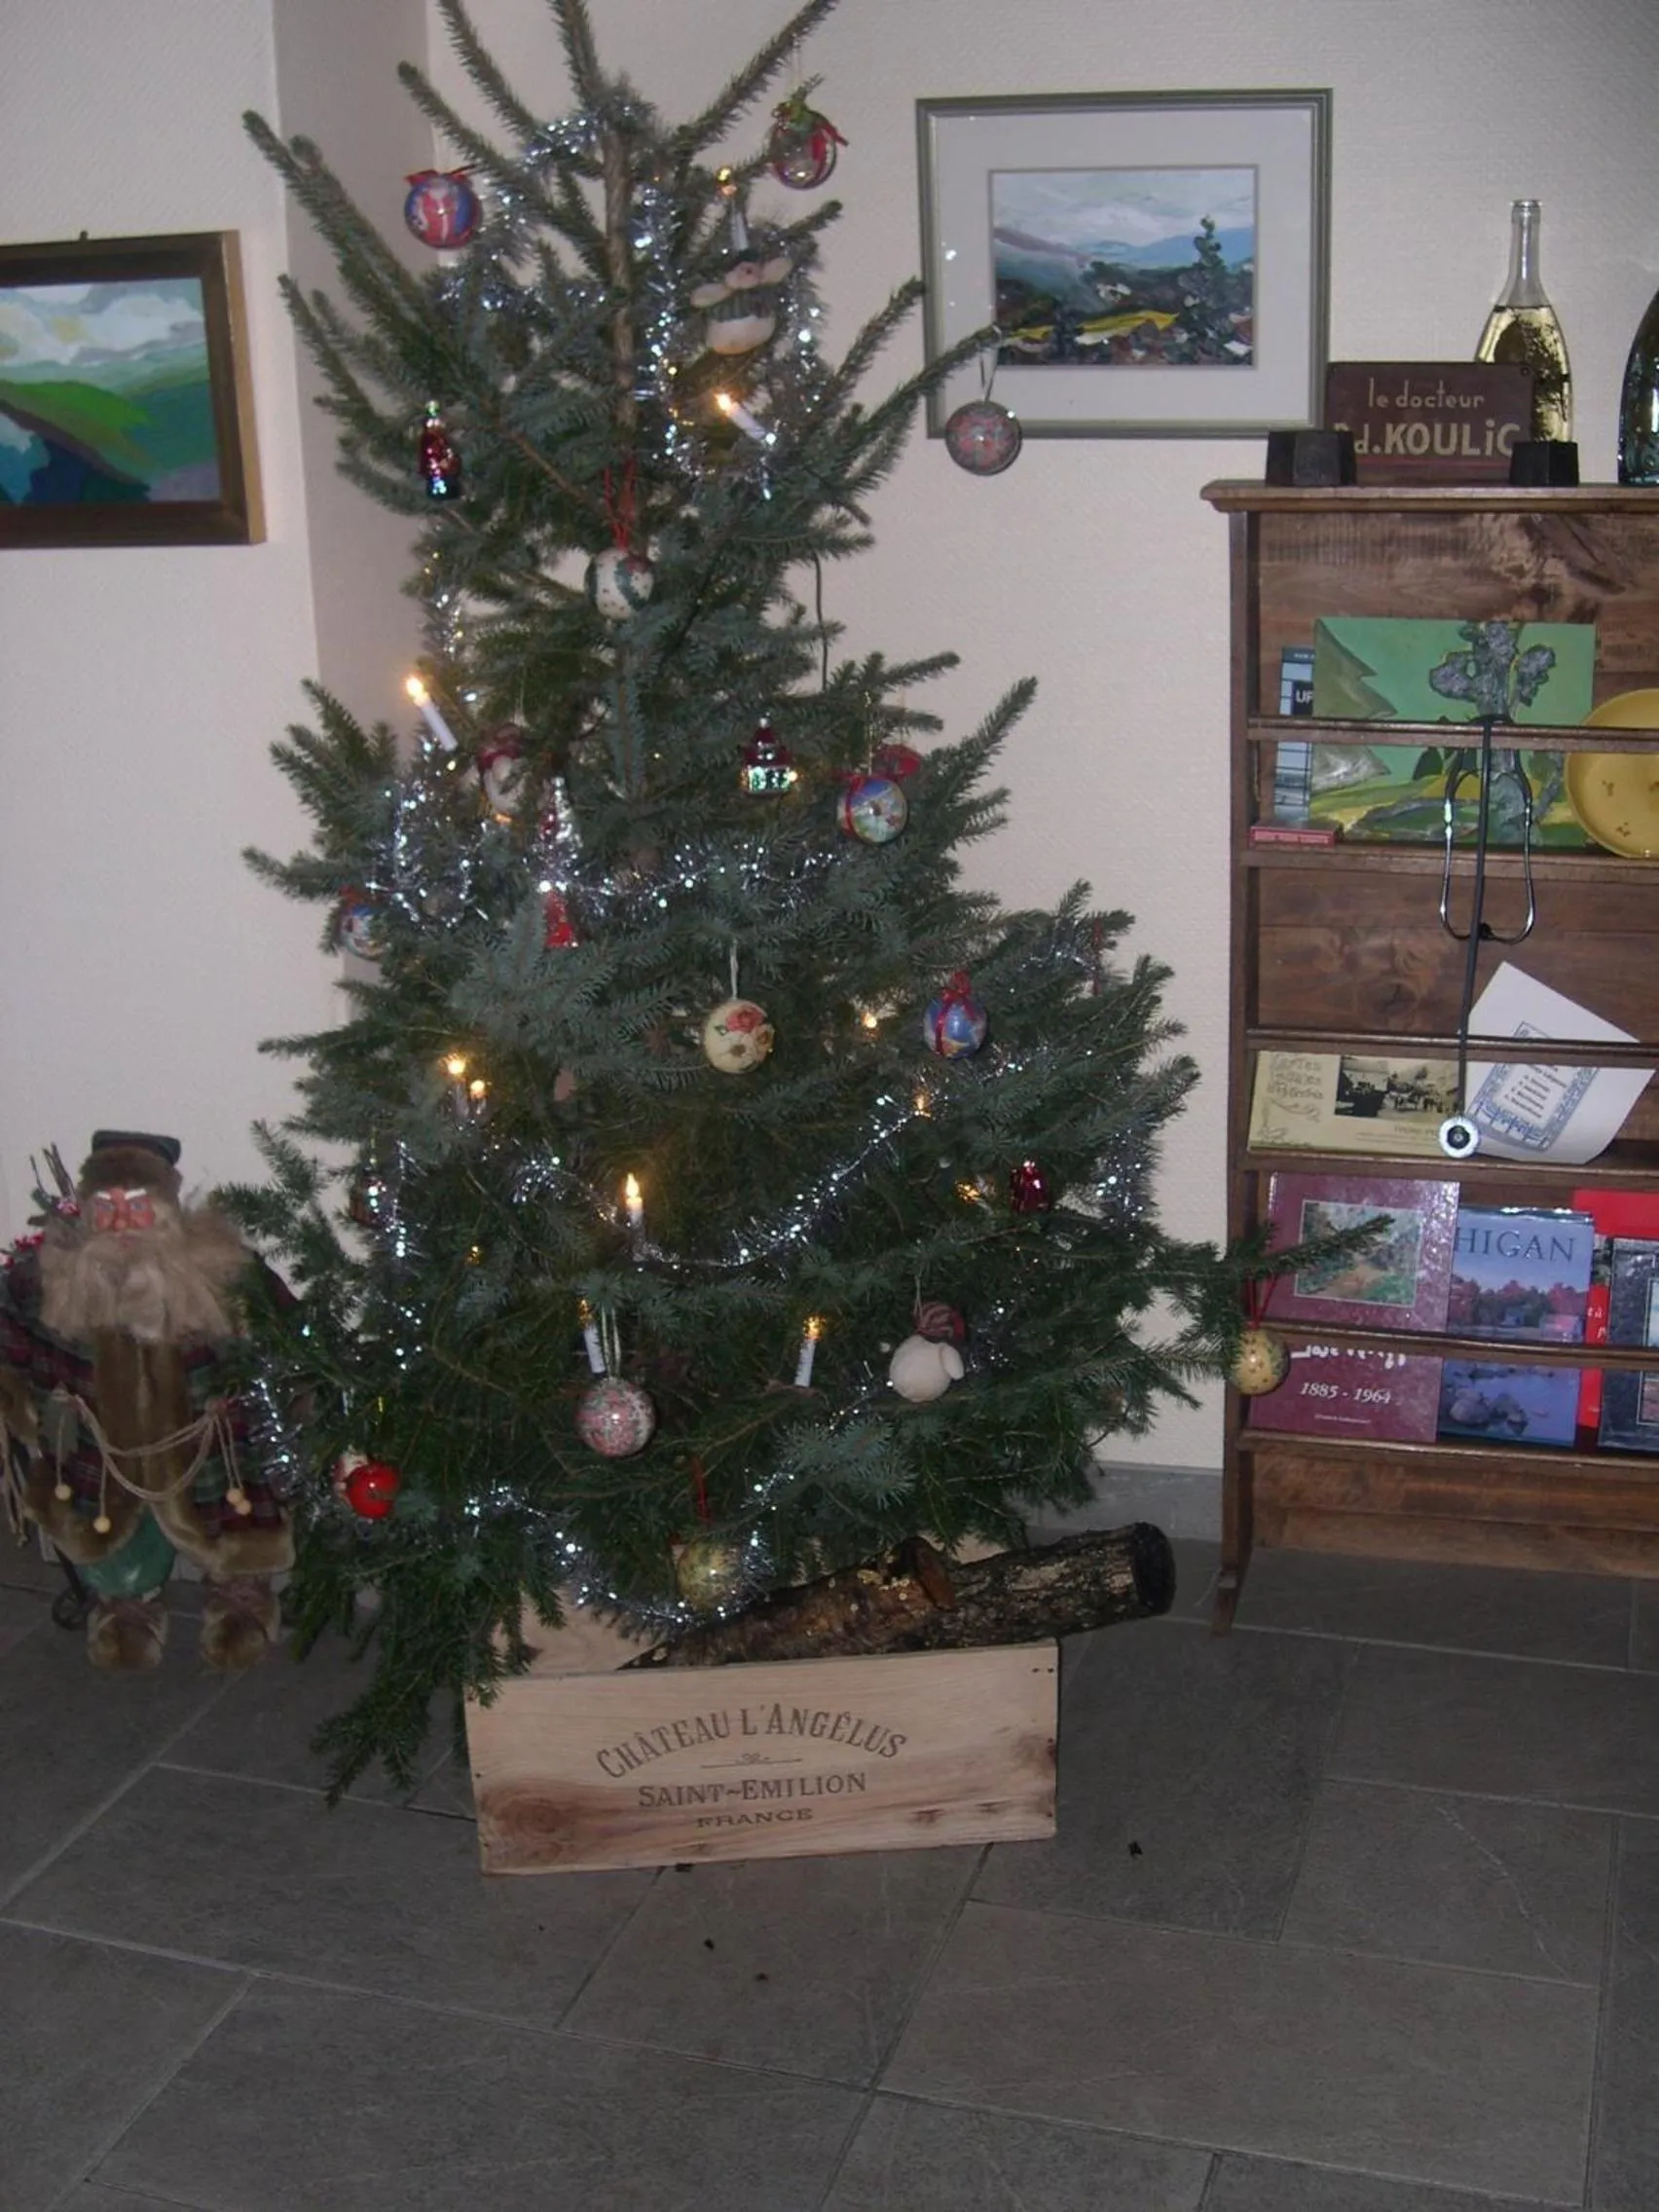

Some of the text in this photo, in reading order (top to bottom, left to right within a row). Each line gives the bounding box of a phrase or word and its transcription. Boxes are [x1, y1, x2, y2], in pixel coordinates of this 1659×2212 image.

[1368, 377, 1485, 409] le docteur
[1301, 1382, 1340, 1399] 1885
[1353, 1387, 1391, 1405] 1964
[638, 1773, 866, 1808] SAINT-EMILION
[696, 1808, 814, 1828] FRANCE
